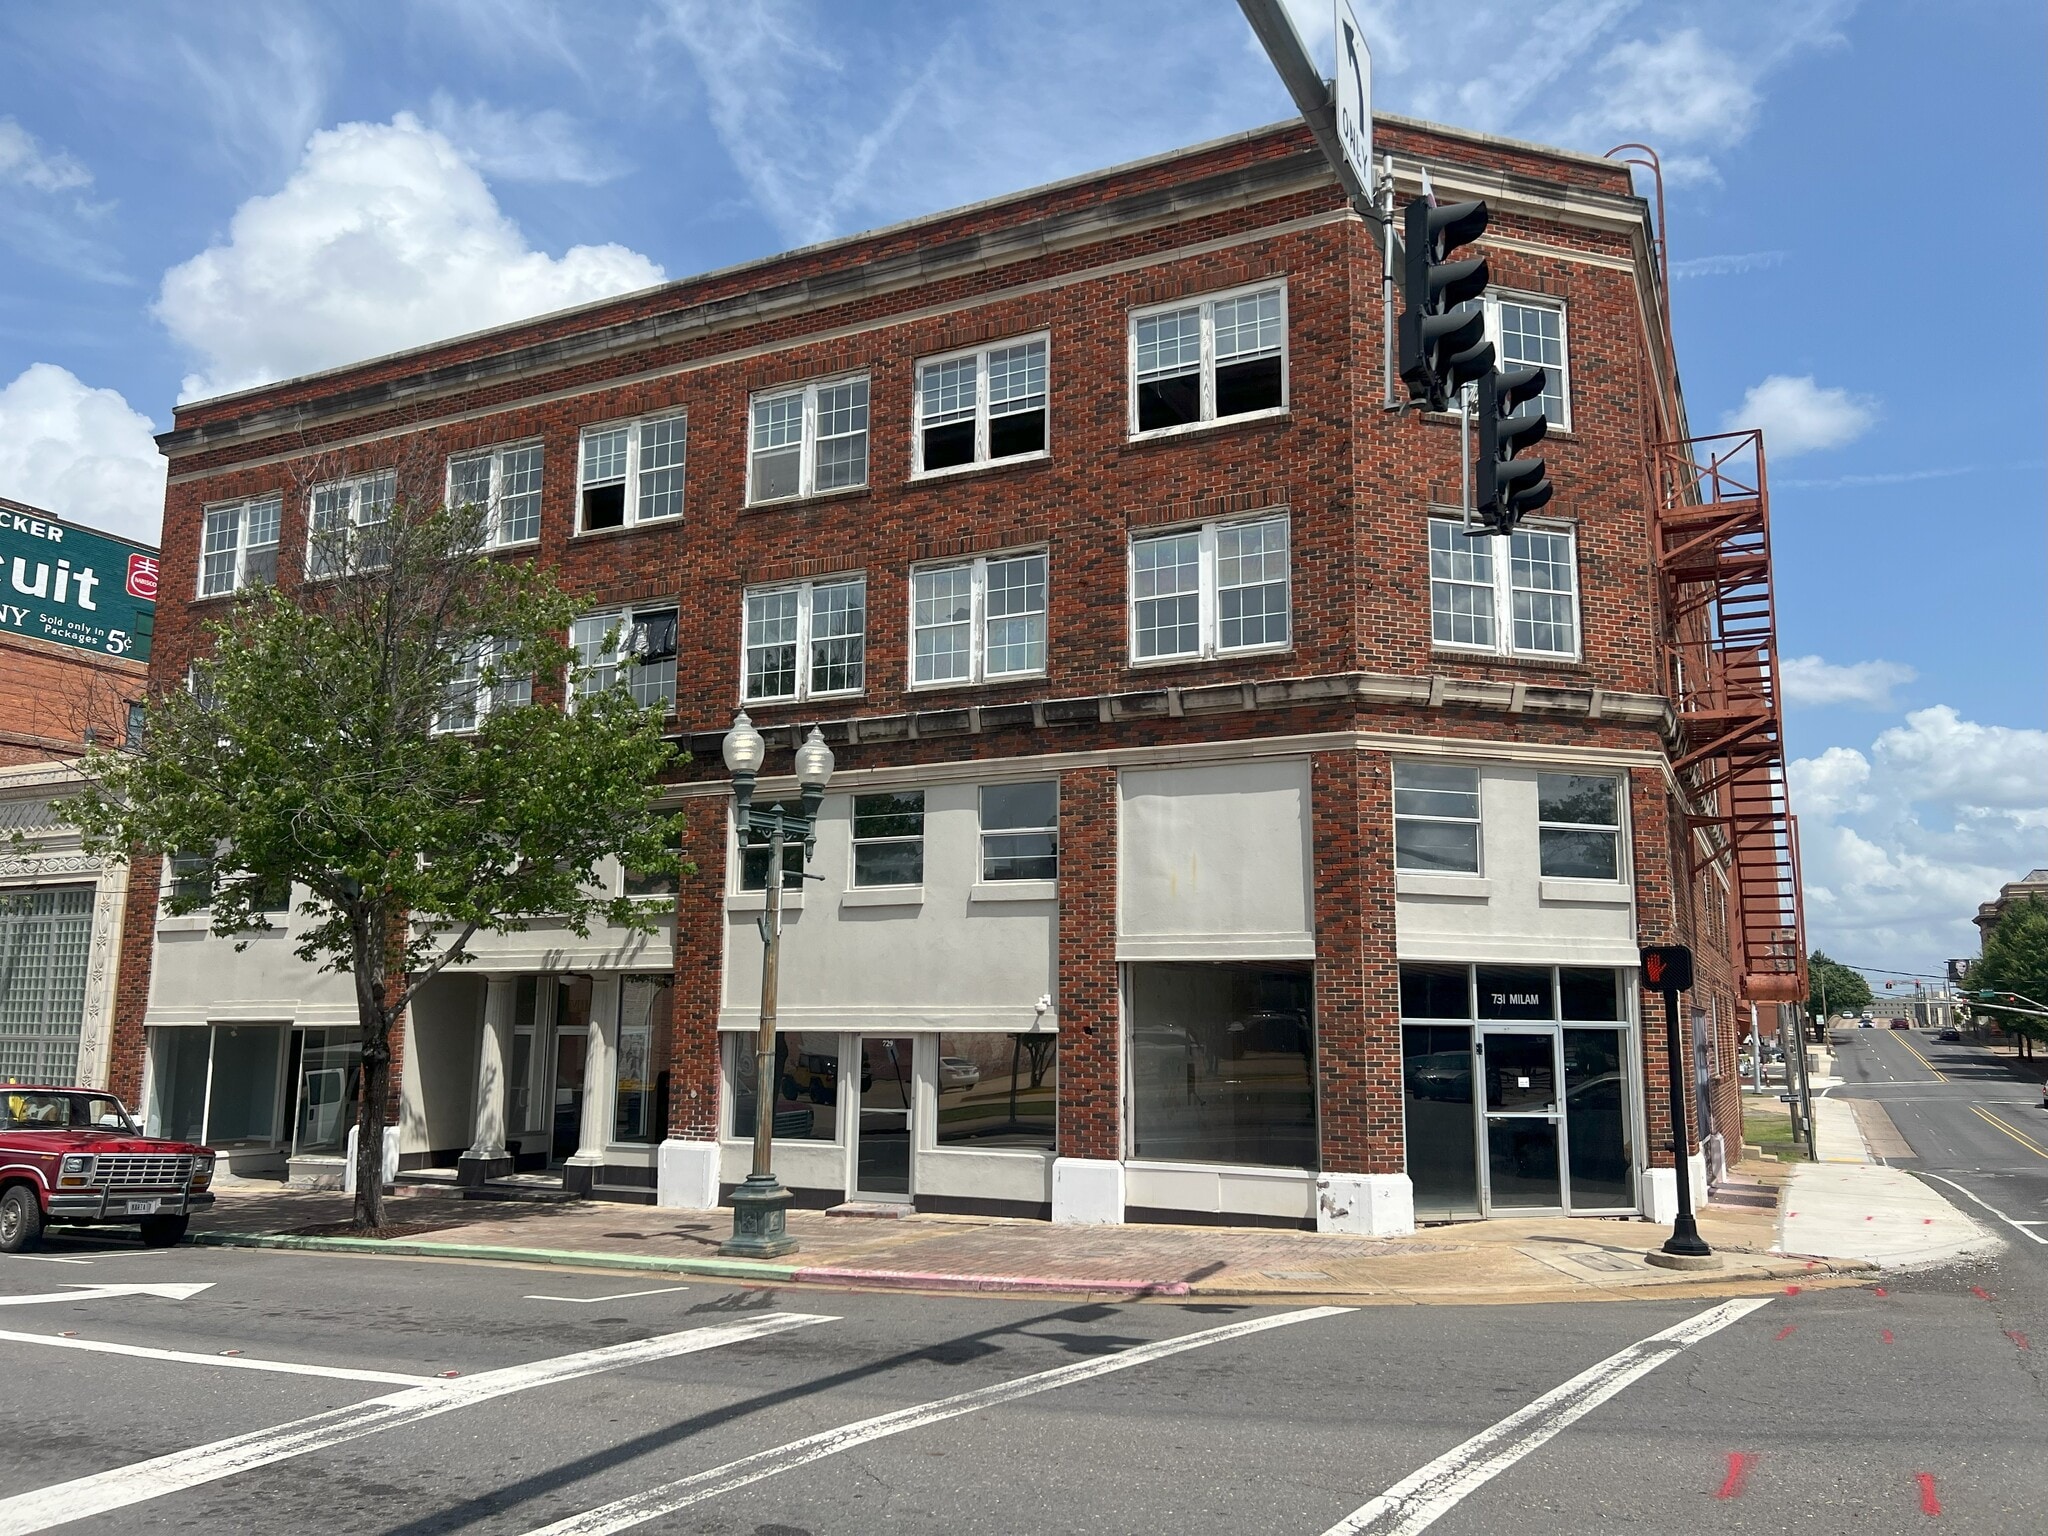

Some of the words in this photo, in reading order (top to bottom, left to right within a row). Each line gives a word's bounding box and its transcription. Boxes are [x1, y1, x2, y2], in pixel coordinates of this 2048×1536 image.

[1342, 107, 1368, 178] ONLY
[0, 511, 64, 543] CKER
[0, 554, 100, 611] uit
[134, 577, 157, 588] NABISCO
[39, 613, 63, 627] Sold
[67, 622, 92, 635] only
[94, 627, 105, 637] in
[44, 624, 98, 644] Packages
[1491, 993, 1506, 1005] 731
[1509, 993, 1539, 1005] MILAM
